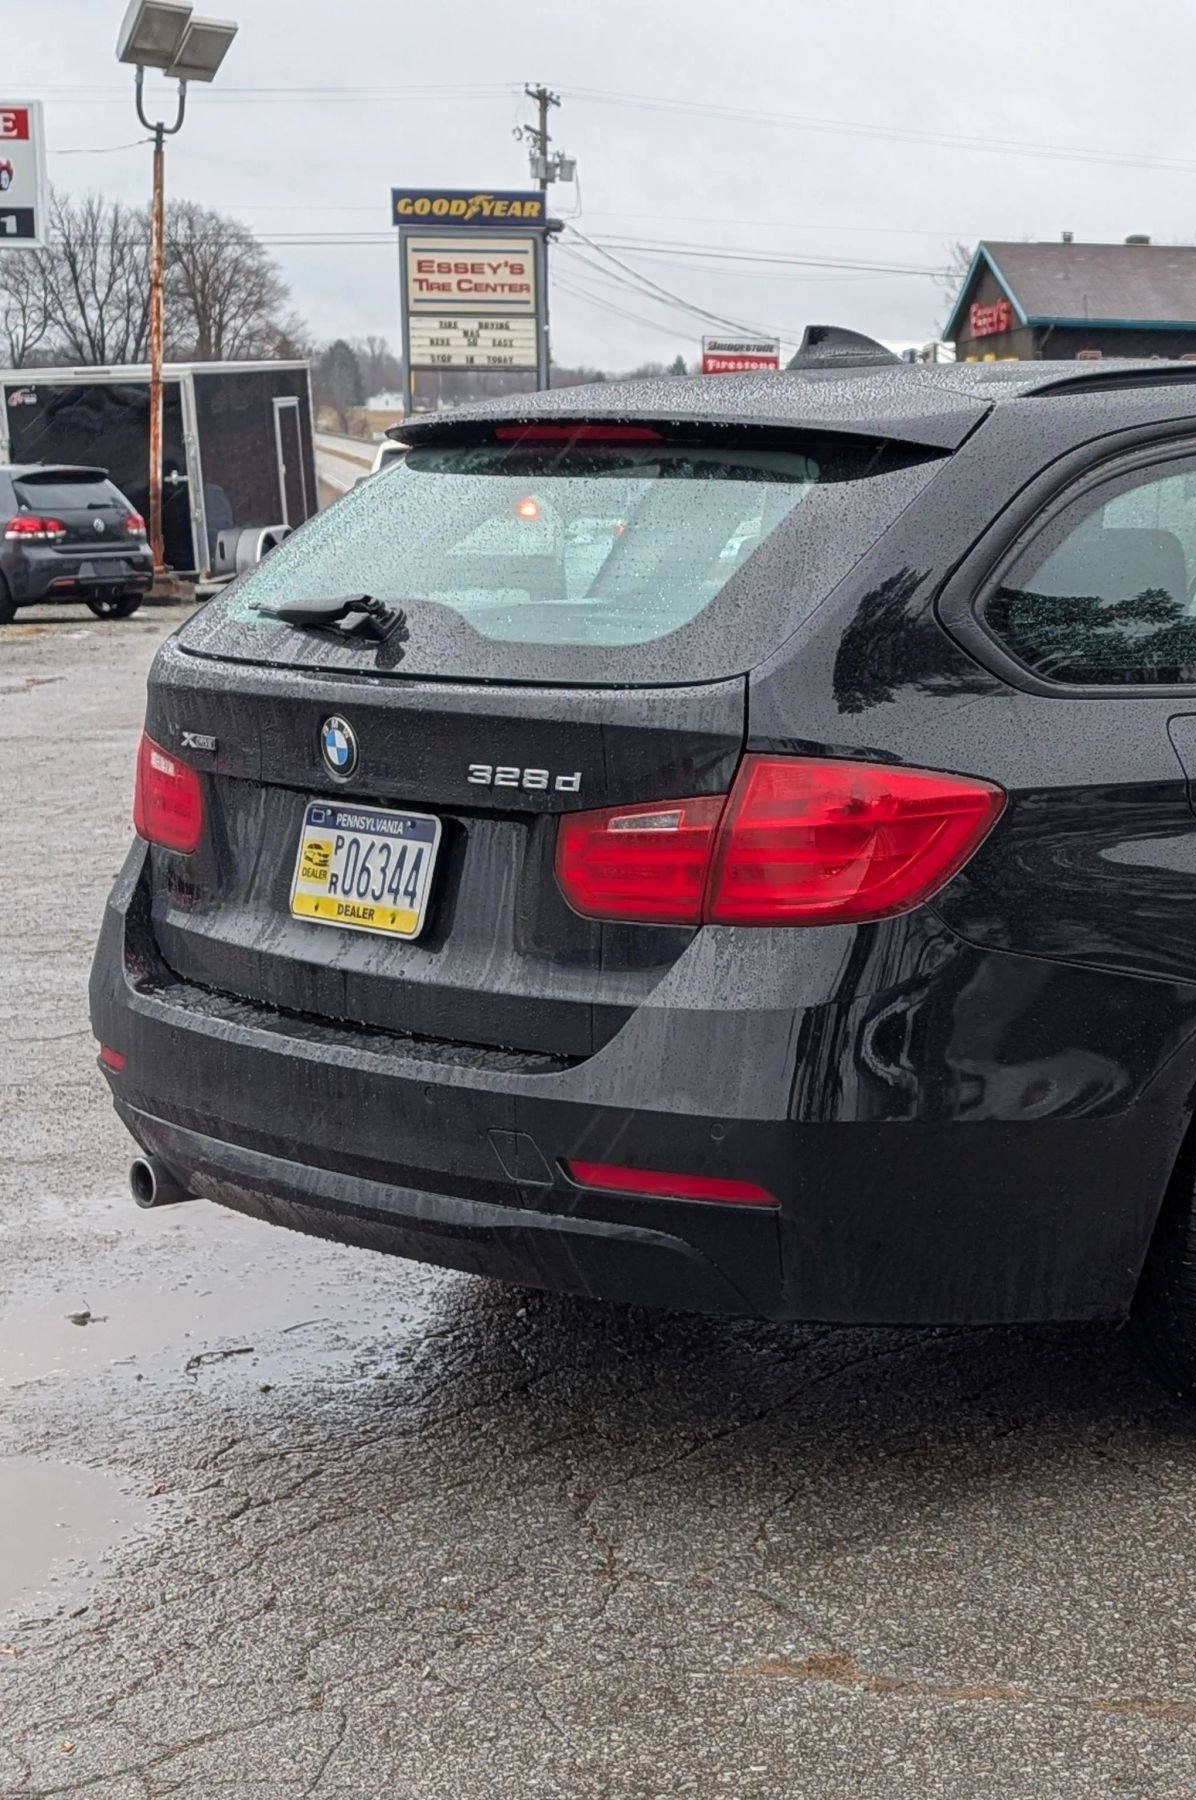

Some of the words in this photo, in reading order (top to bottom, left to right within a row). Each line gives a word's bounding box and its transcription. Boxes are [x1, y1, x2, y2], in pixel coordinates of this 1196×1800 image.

[397, 196, 541, 219] GOODYEAR
[416, 259, 525, 276] ESSEY'S
[413, 278, 452, 293] TIRE
[457, 279, 531, 294] CENTER
[336, 812, 404, 835] PENNSYLVANIA
[302, 866, 328, 881] DEALER
[337, 903, 375, 921] DEALER
